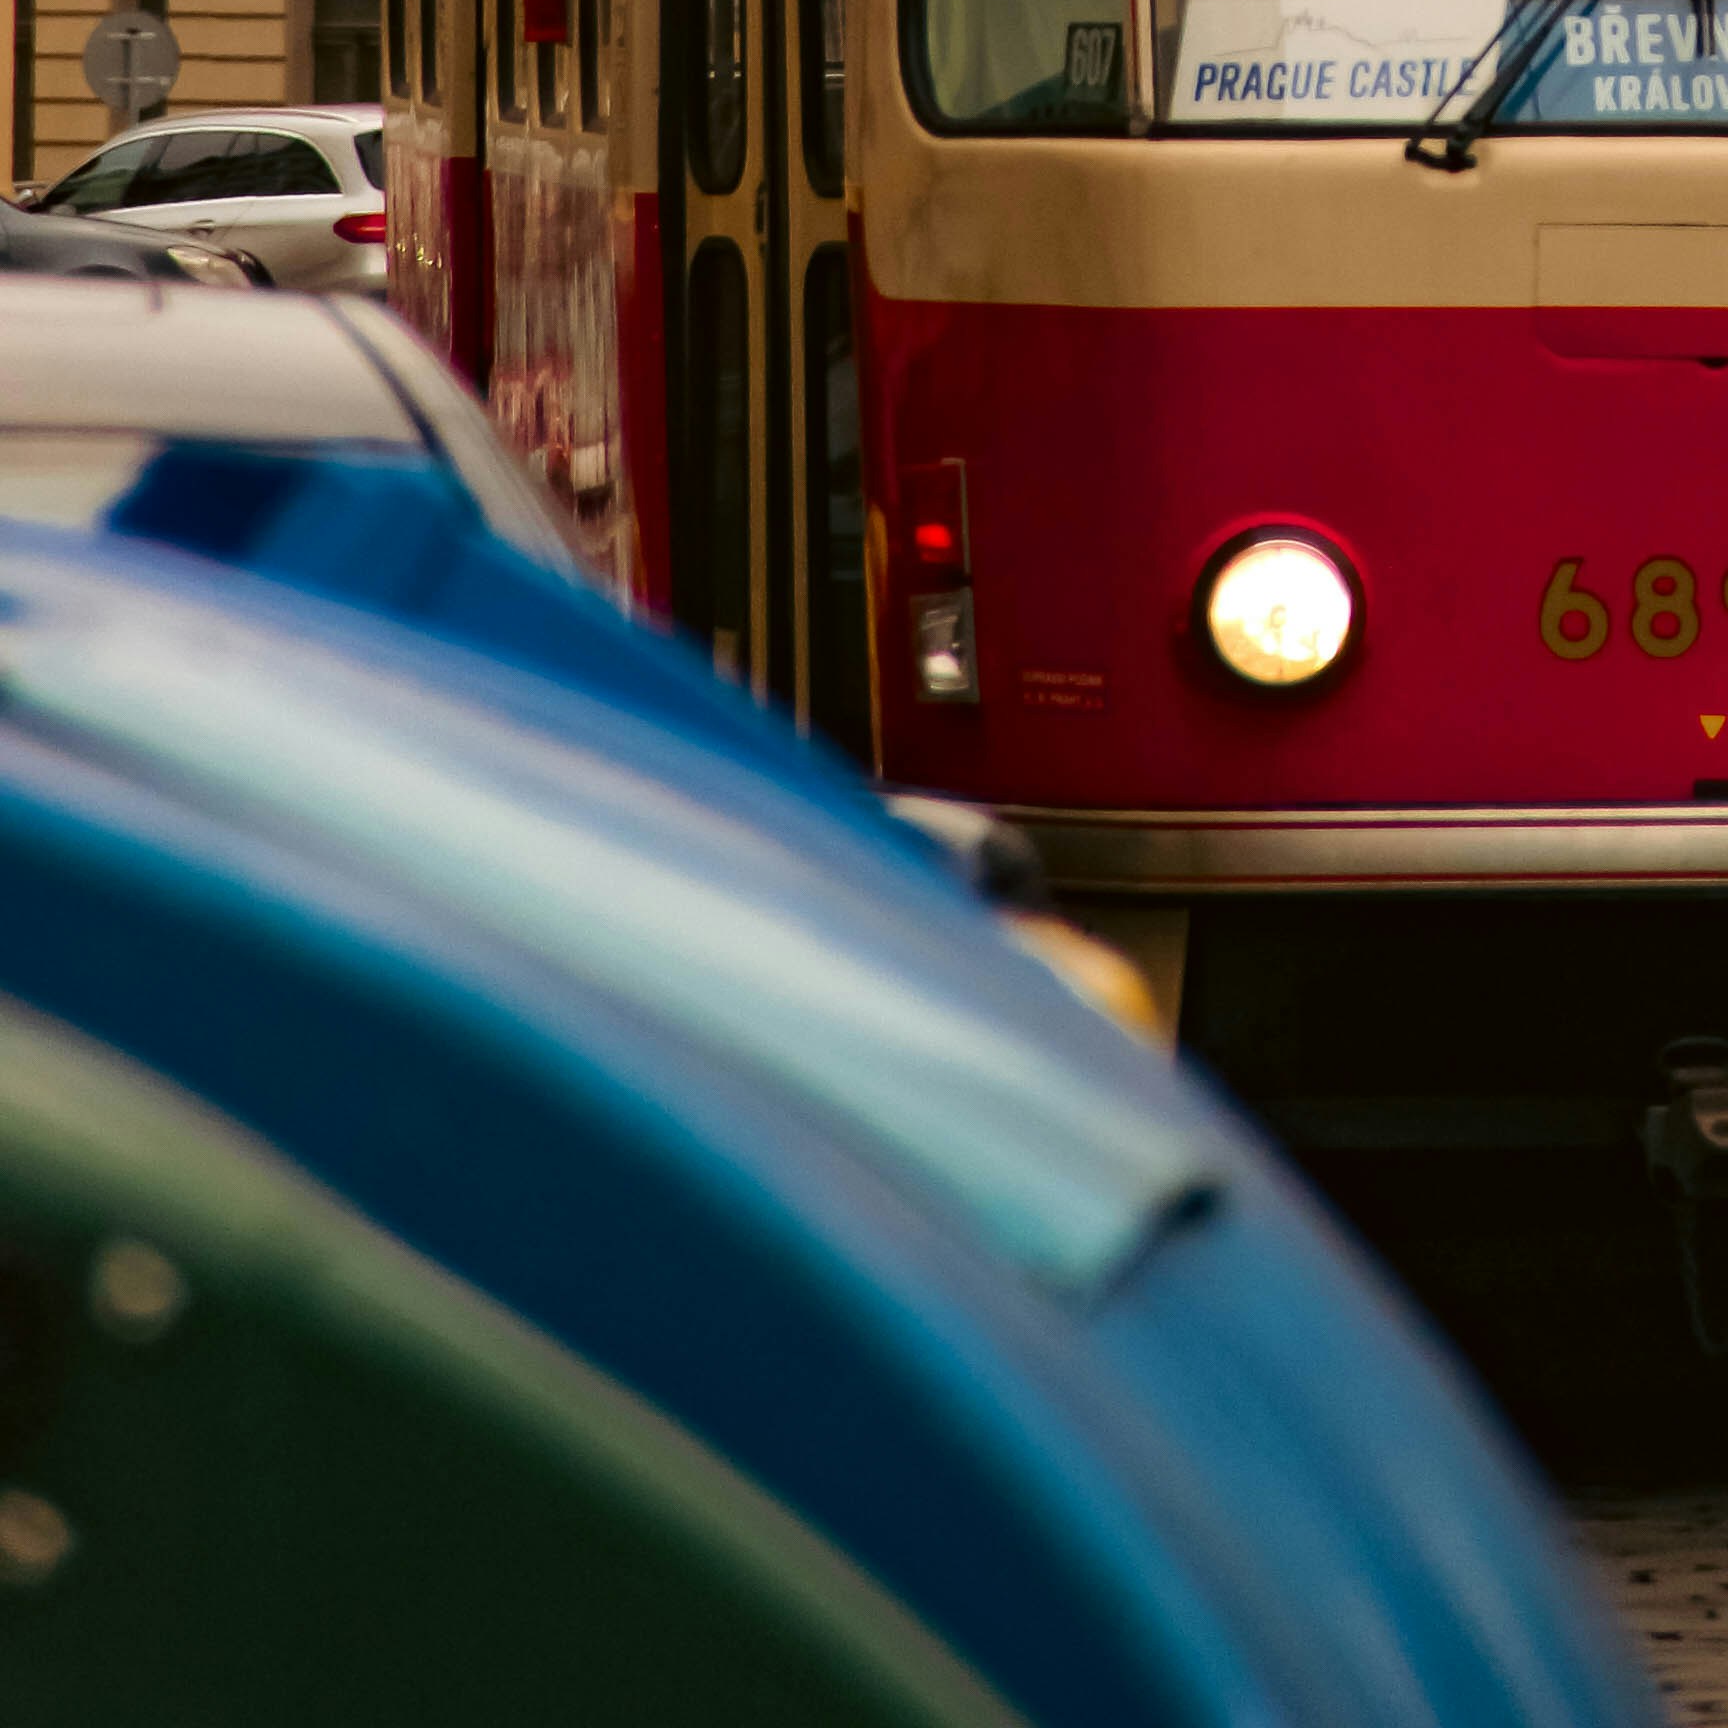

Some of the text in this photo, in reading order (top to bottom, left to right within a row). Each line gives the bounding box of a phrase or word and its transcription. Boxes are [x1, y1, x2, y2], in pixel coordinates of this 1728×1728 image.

[1071, 27, 1116, 87] 607
[1194, 56, 1479, 102] PRAGUE CASTLE
